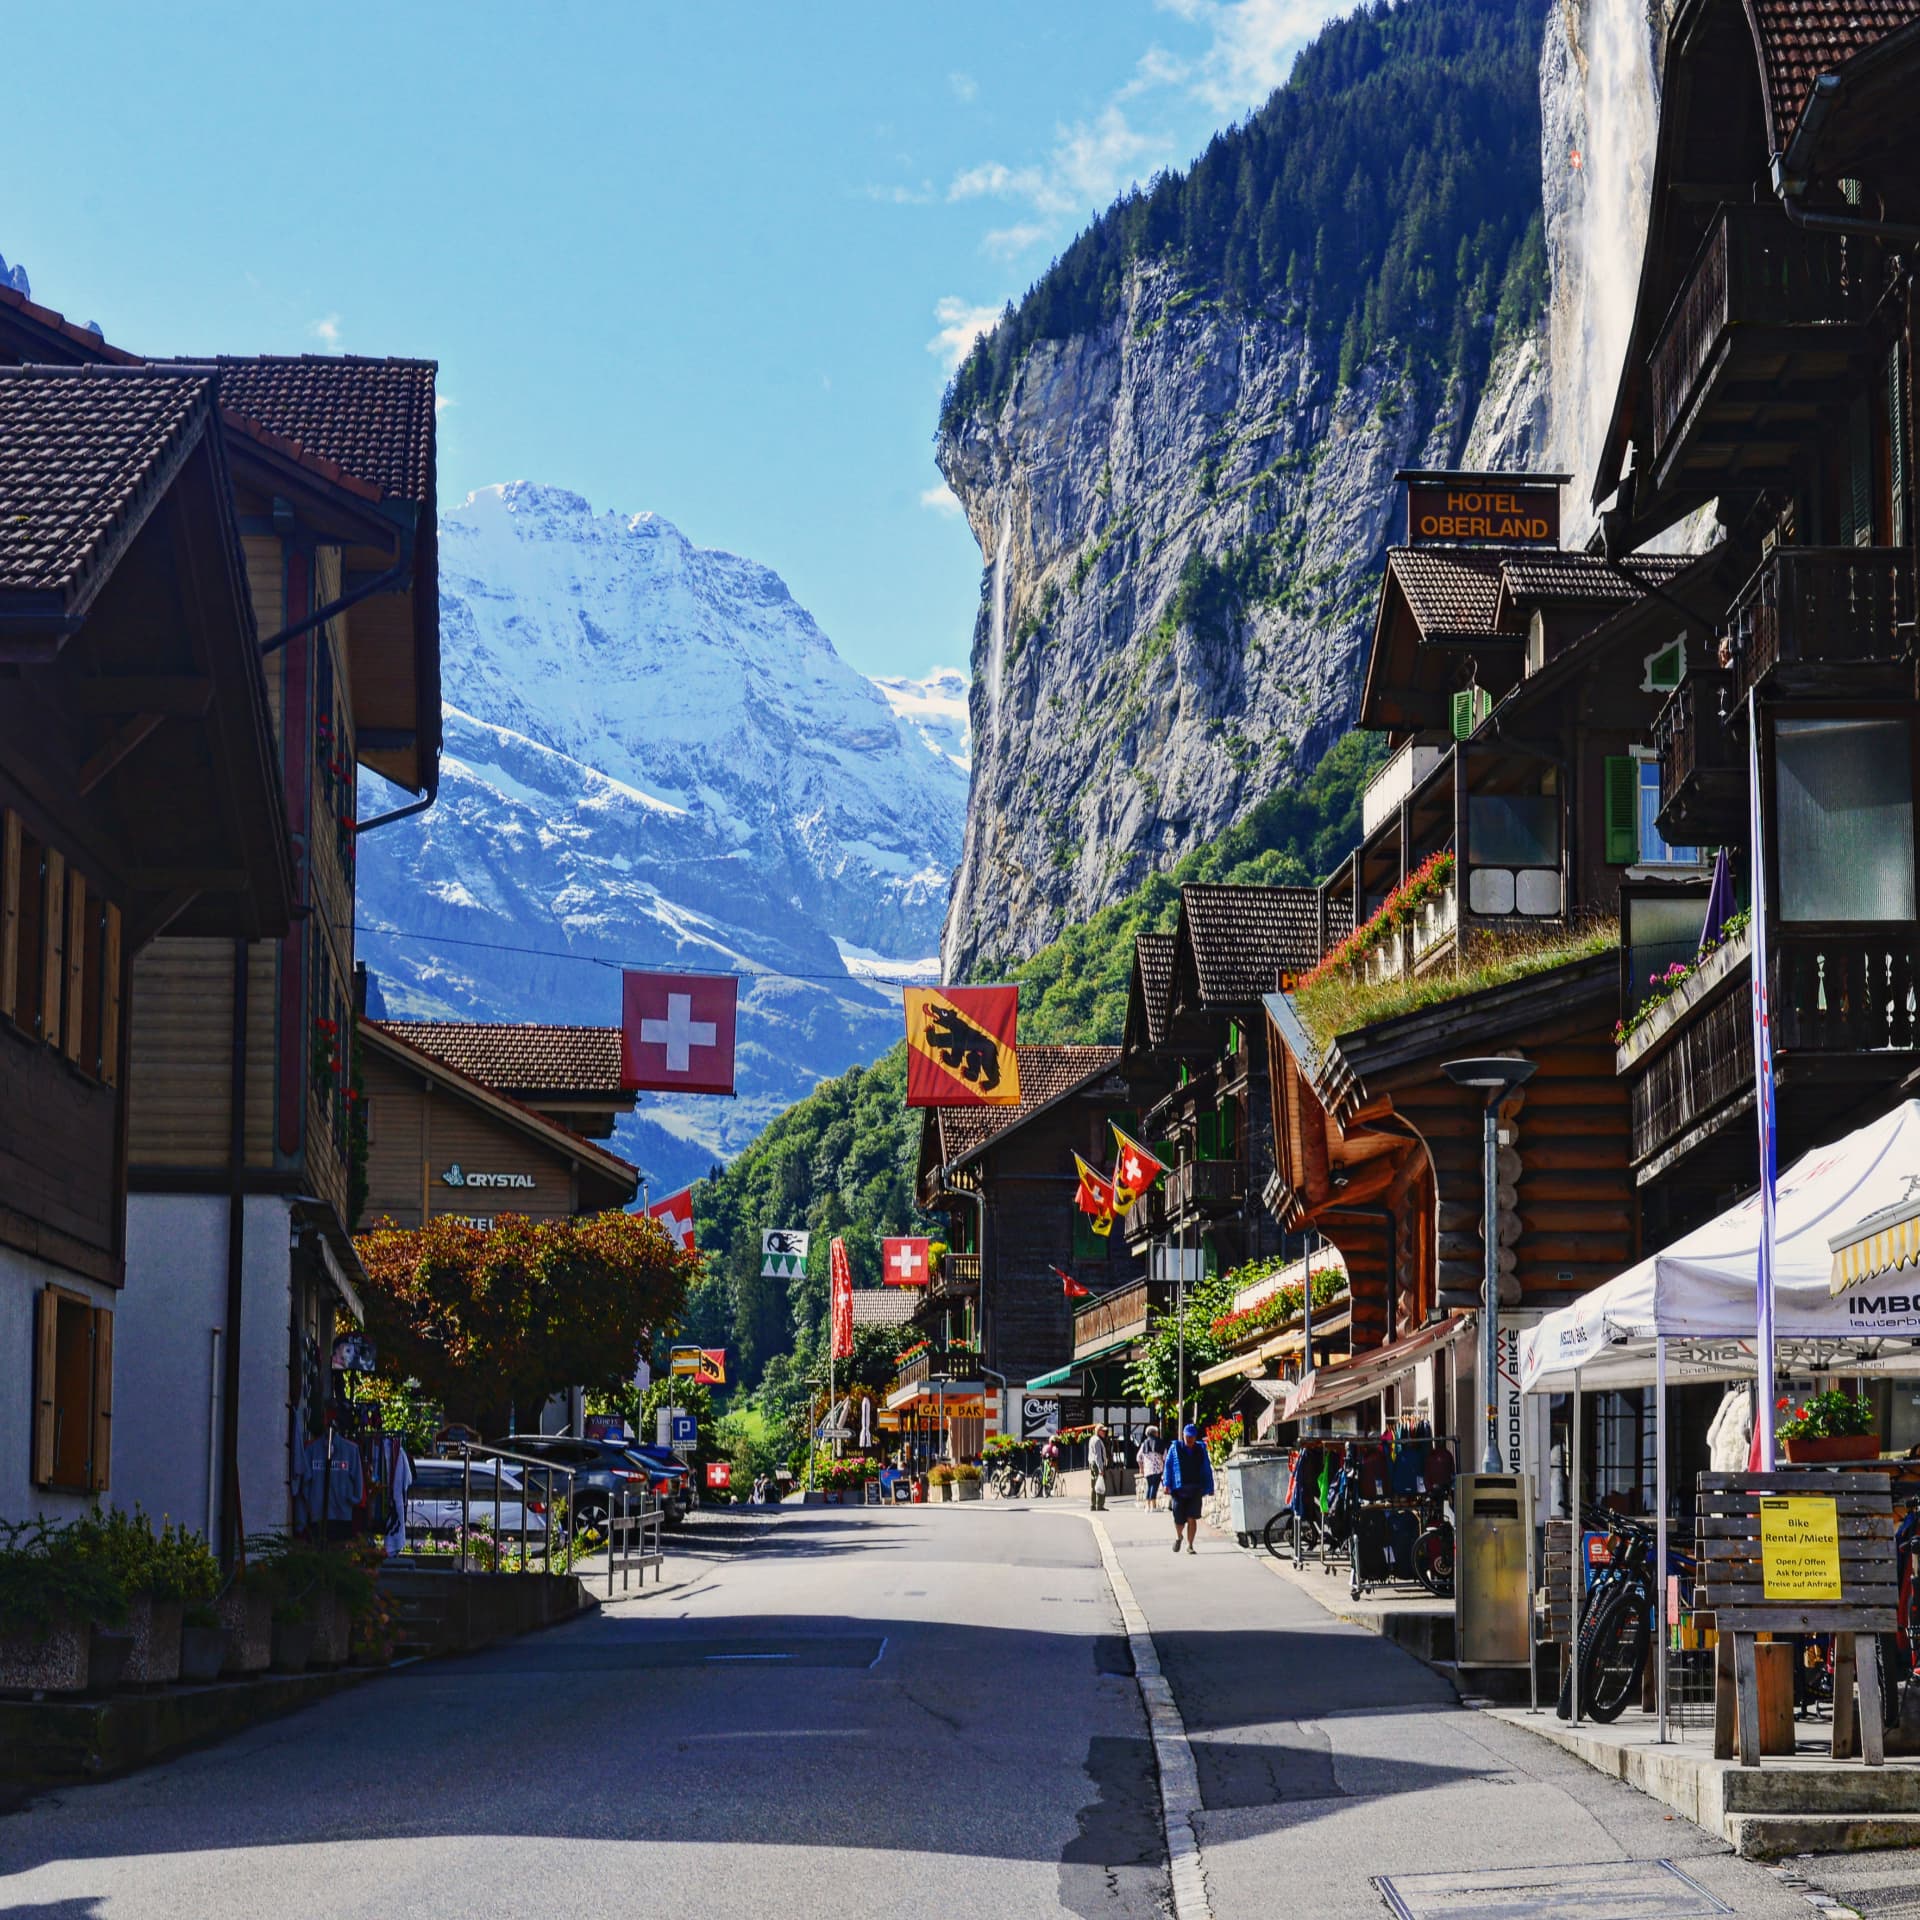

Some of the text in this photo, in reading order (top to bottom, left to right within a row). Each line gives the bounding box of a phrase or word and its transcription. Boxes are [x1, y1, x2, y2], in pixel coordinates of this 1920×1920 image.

[1447, 492, 1524, 513] HOTEL
[1420, 515, 1549, 538] OBERLAND
[466, 1173, 536, 1188] CRYSTAL
[1508, 1329, 1521, 1475] MBODEN BIKE
[958, 1405, 982, 1416] BAR
[679, 1420, 691, 1438] P
[1788, 1519, 1809, 1528] Bike
[1765, 1533, 1834, 1544] Rental /Miete
[1776, 1559, 1797, 1567] Open
[1776, 1569, 1827, 1578] Ask for prices
[1768, 1580, 1838, 1589] Preise auf Anfrage
